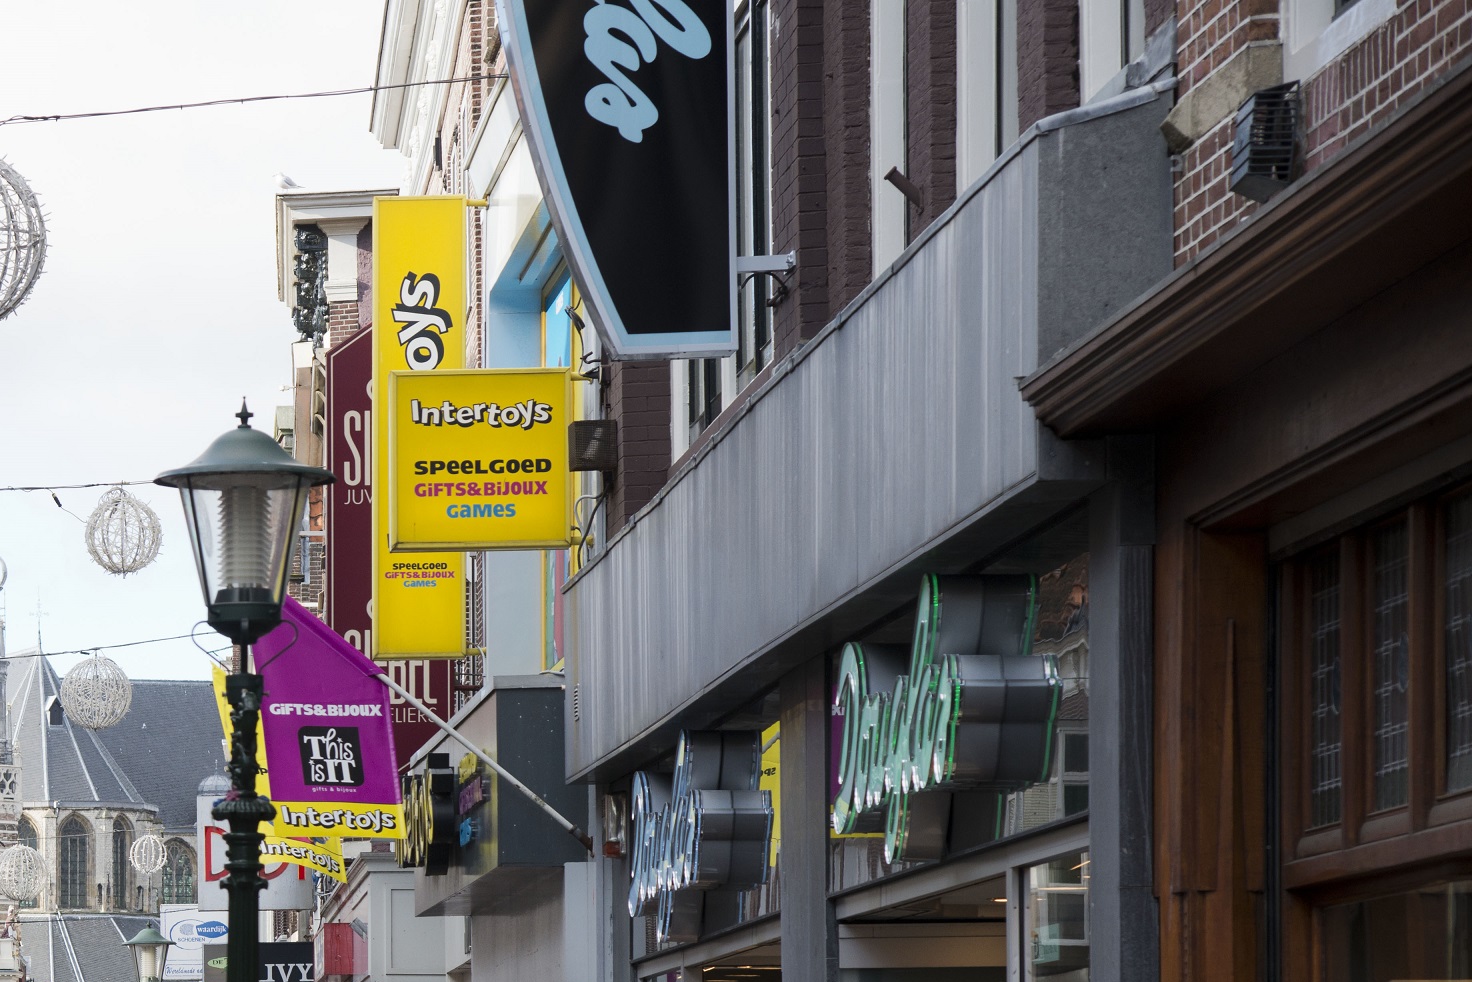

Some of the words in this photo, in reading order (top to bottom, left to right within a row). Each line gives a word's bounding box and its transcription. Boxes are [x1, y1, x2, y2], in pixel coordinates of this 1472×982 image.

[411, 399, 553, 431] Intertoys
[303, 727, 354, 761] This
[281, 805, 396, 832] Intertoys
[260, 839, 341, 874] Intertoys
[196, 924, 227, 935] waardijk
[264, 963, 314, 982] IVY
